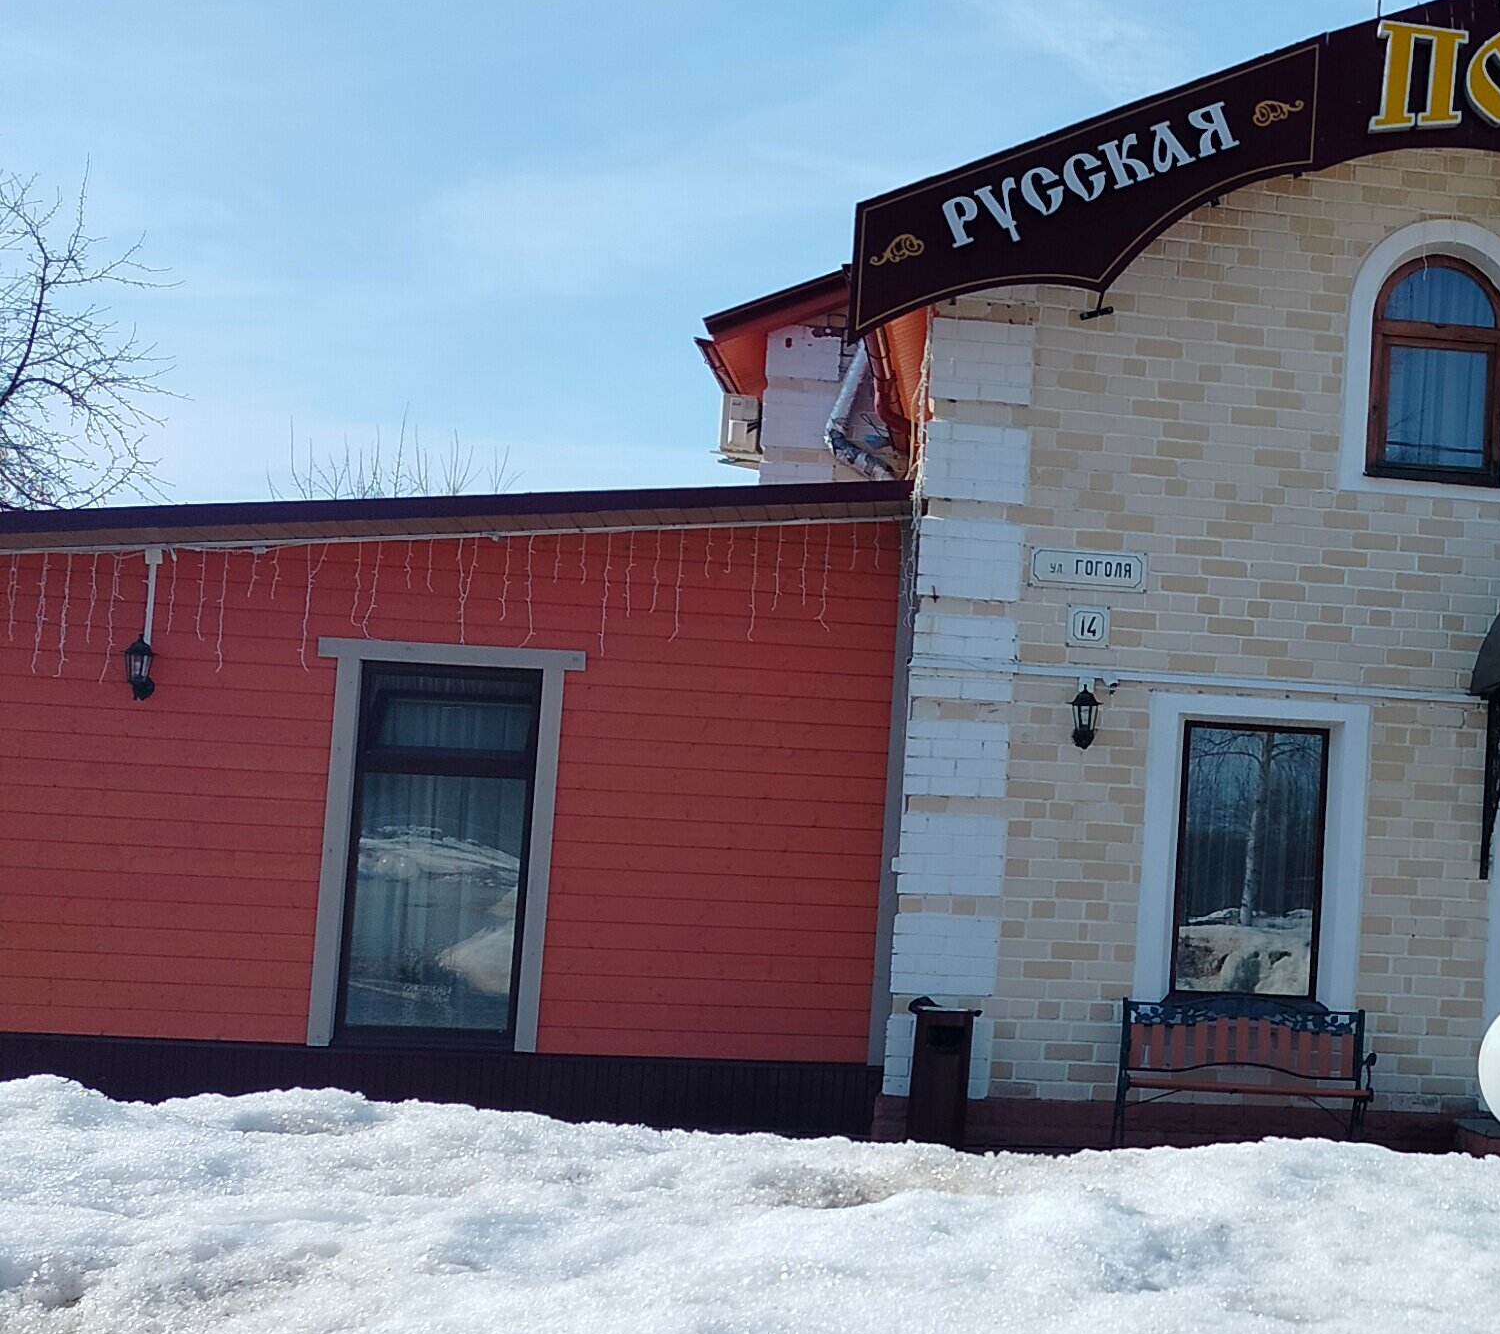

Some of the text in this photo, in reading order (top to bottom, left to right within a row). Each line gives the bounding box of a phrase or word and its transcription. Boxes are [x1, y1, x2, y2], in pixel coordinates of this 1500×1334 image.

[941, 101, 1240, 249] РУССКАЯ
[1075, 559, 1132, 578] ГОГОЛЯ
[1080, 616, 1097, 637] 14
